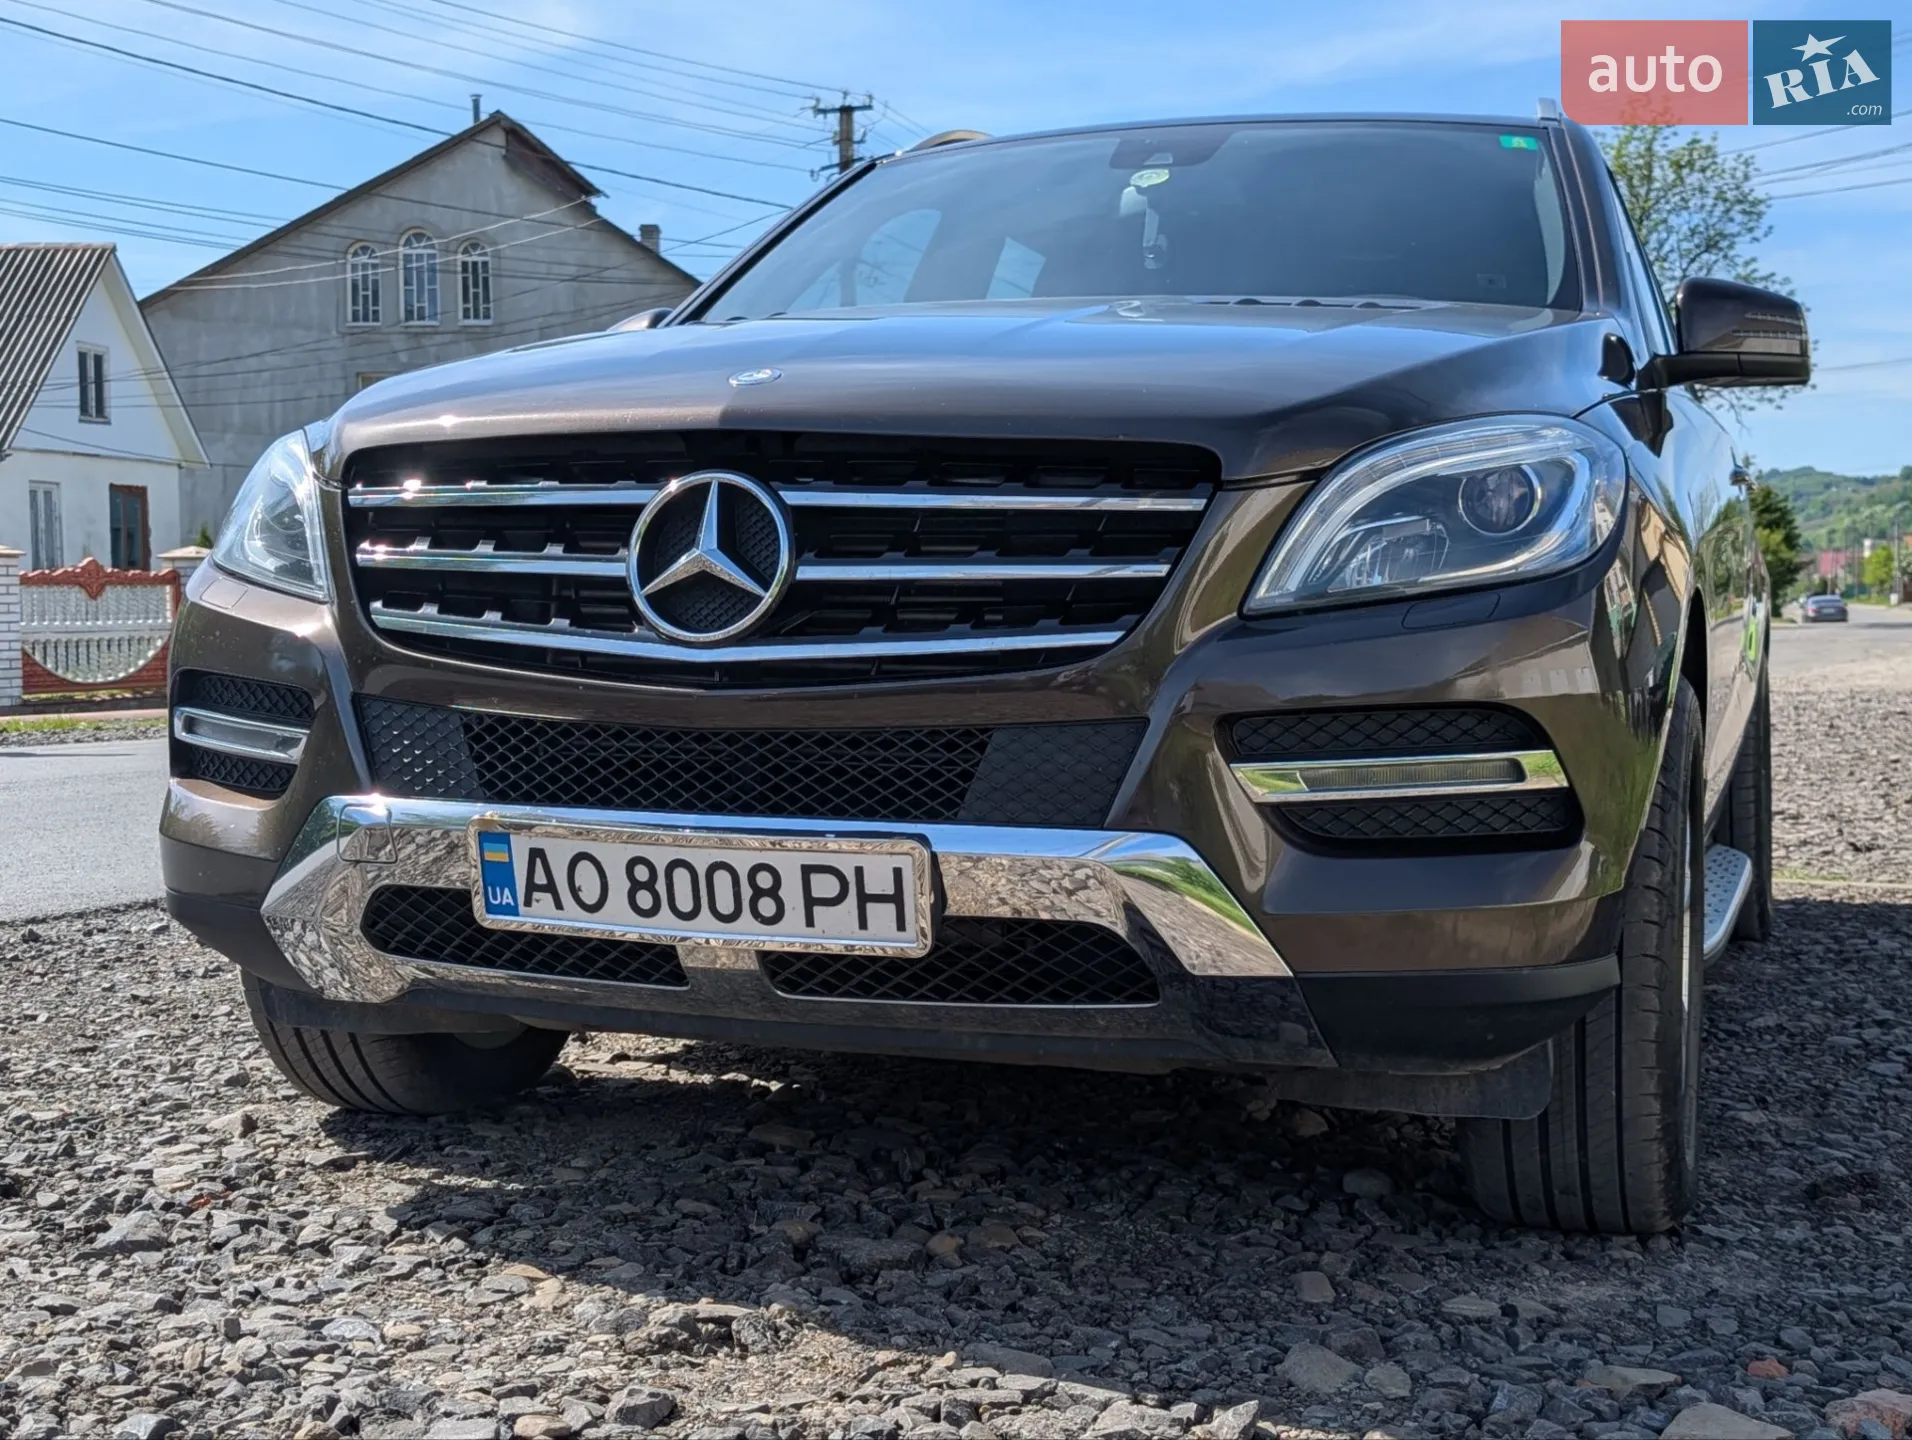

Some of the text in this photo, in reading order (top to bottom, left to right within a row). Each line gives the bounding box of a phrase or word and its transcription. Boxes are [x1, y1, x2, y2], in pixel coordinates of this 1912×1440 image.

[487, 886, 515, 906] UA
[522, 846, 907, 933] AO 8008 PH
